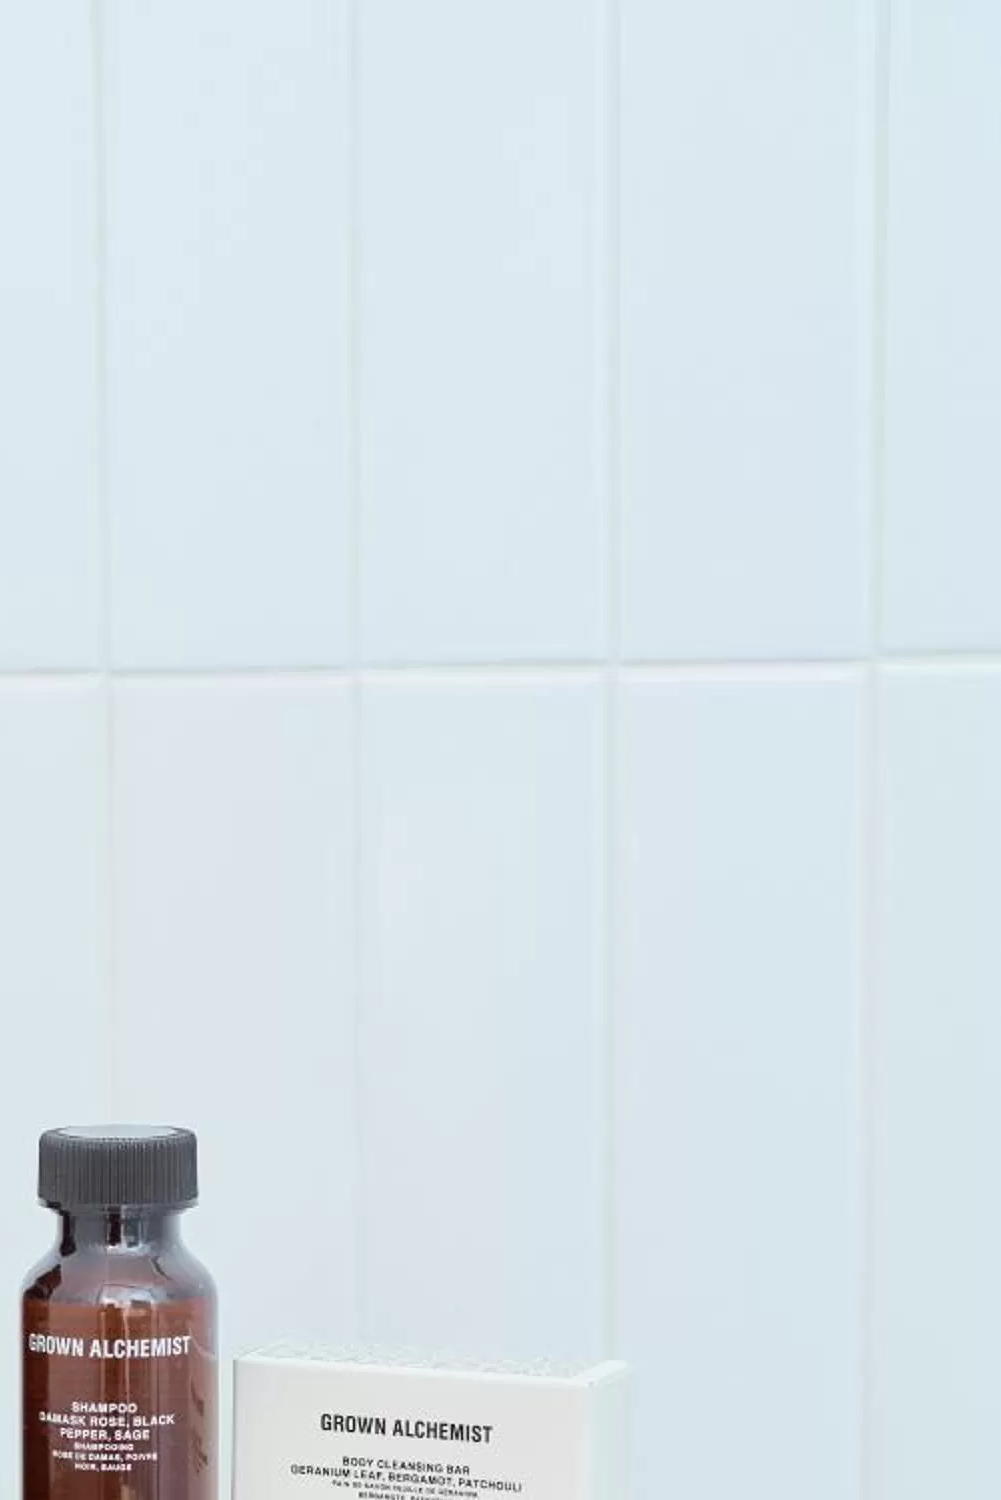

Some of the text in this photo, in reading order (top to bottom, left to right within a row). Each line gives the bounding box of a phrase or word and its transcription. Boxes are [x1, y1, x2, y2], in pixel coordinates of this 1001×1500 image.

[29, 1333, 191, 1359] GROWN ALCHEMIST
[71, 1402, 138, 1413] SHAMPOO
[39, 1412, 175, 1428] DAMASK ROSE, BLACK
[320, 1414, 493, 1443] GROWN ALCHEMIST
[60, 1427, 150, 1442] PEPPER, SAGE
[74, 1442, 134, 1451] SHAMPOOING
[342, 1456, 470, 1475] BODY CLEANSING BAR
[290, 1464, 350, 1478] GERANIUM
[354, 1469, 386, 1482] LEAF,
[458, 1478, 522, 1492] PATCHOULI
